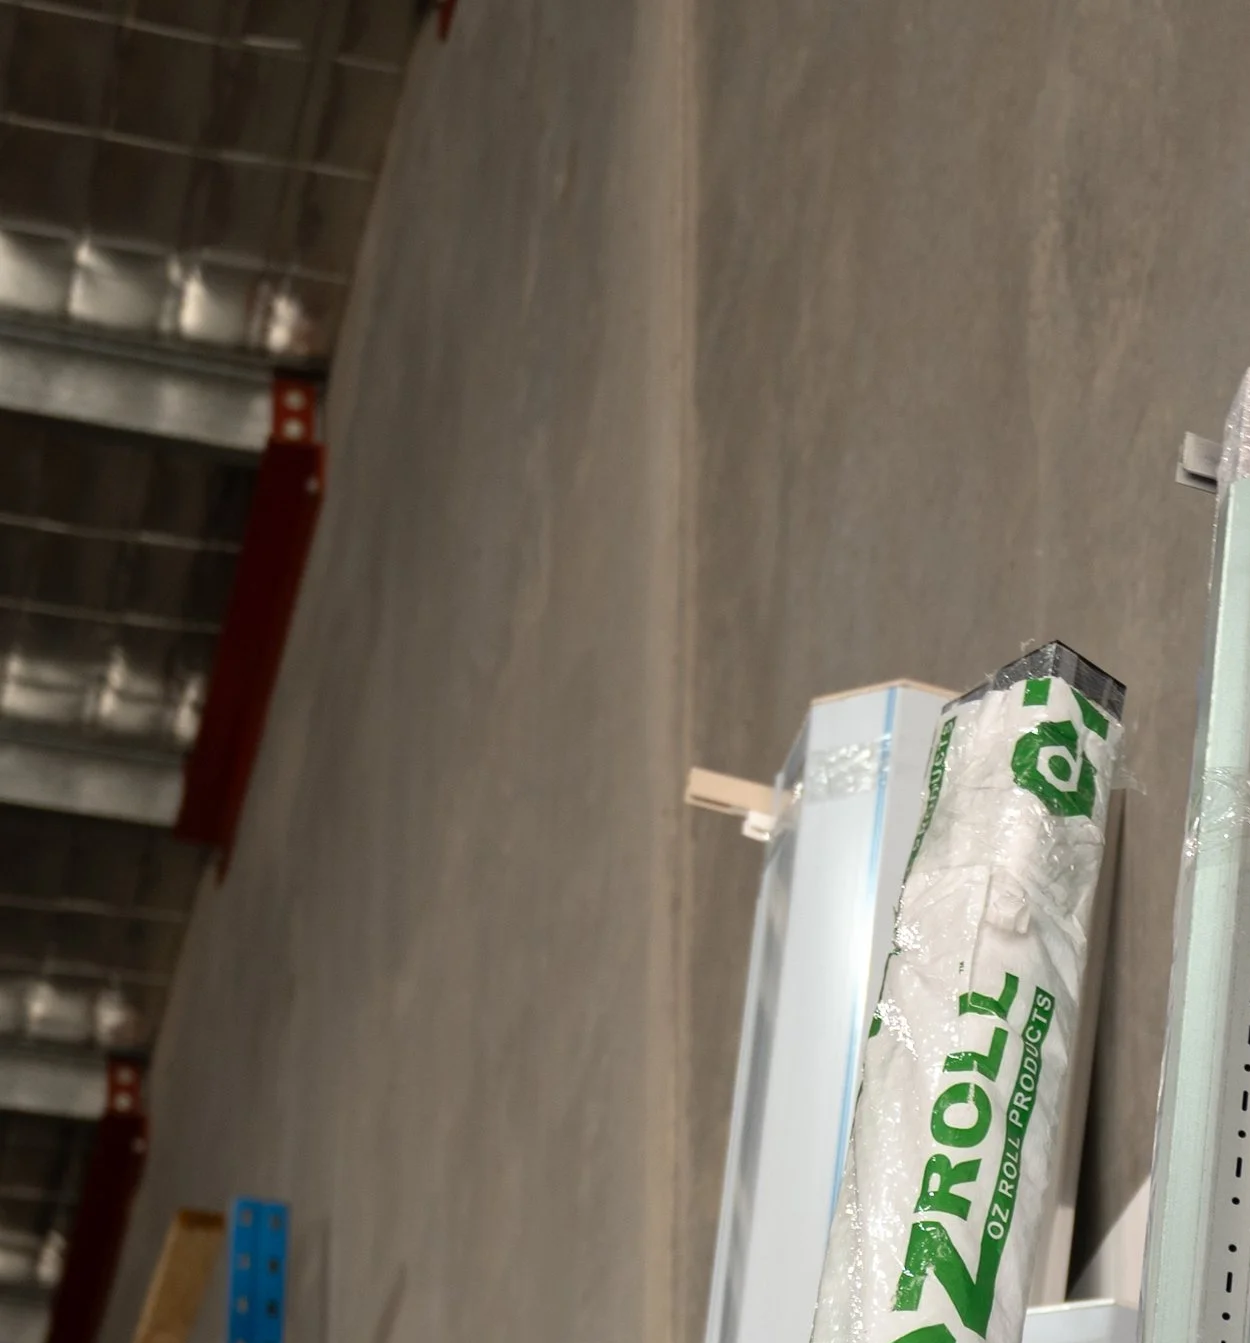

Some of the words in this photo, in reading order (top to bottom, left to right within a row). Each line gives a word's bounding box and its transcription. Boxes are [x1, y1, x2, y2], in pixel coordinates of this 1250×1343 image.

[1008, 992, 1052, 1128] PRODUCTS
[998, 1136, 1021, 1199] ROLL
[987, 1206, 1010, 1240] OZ
